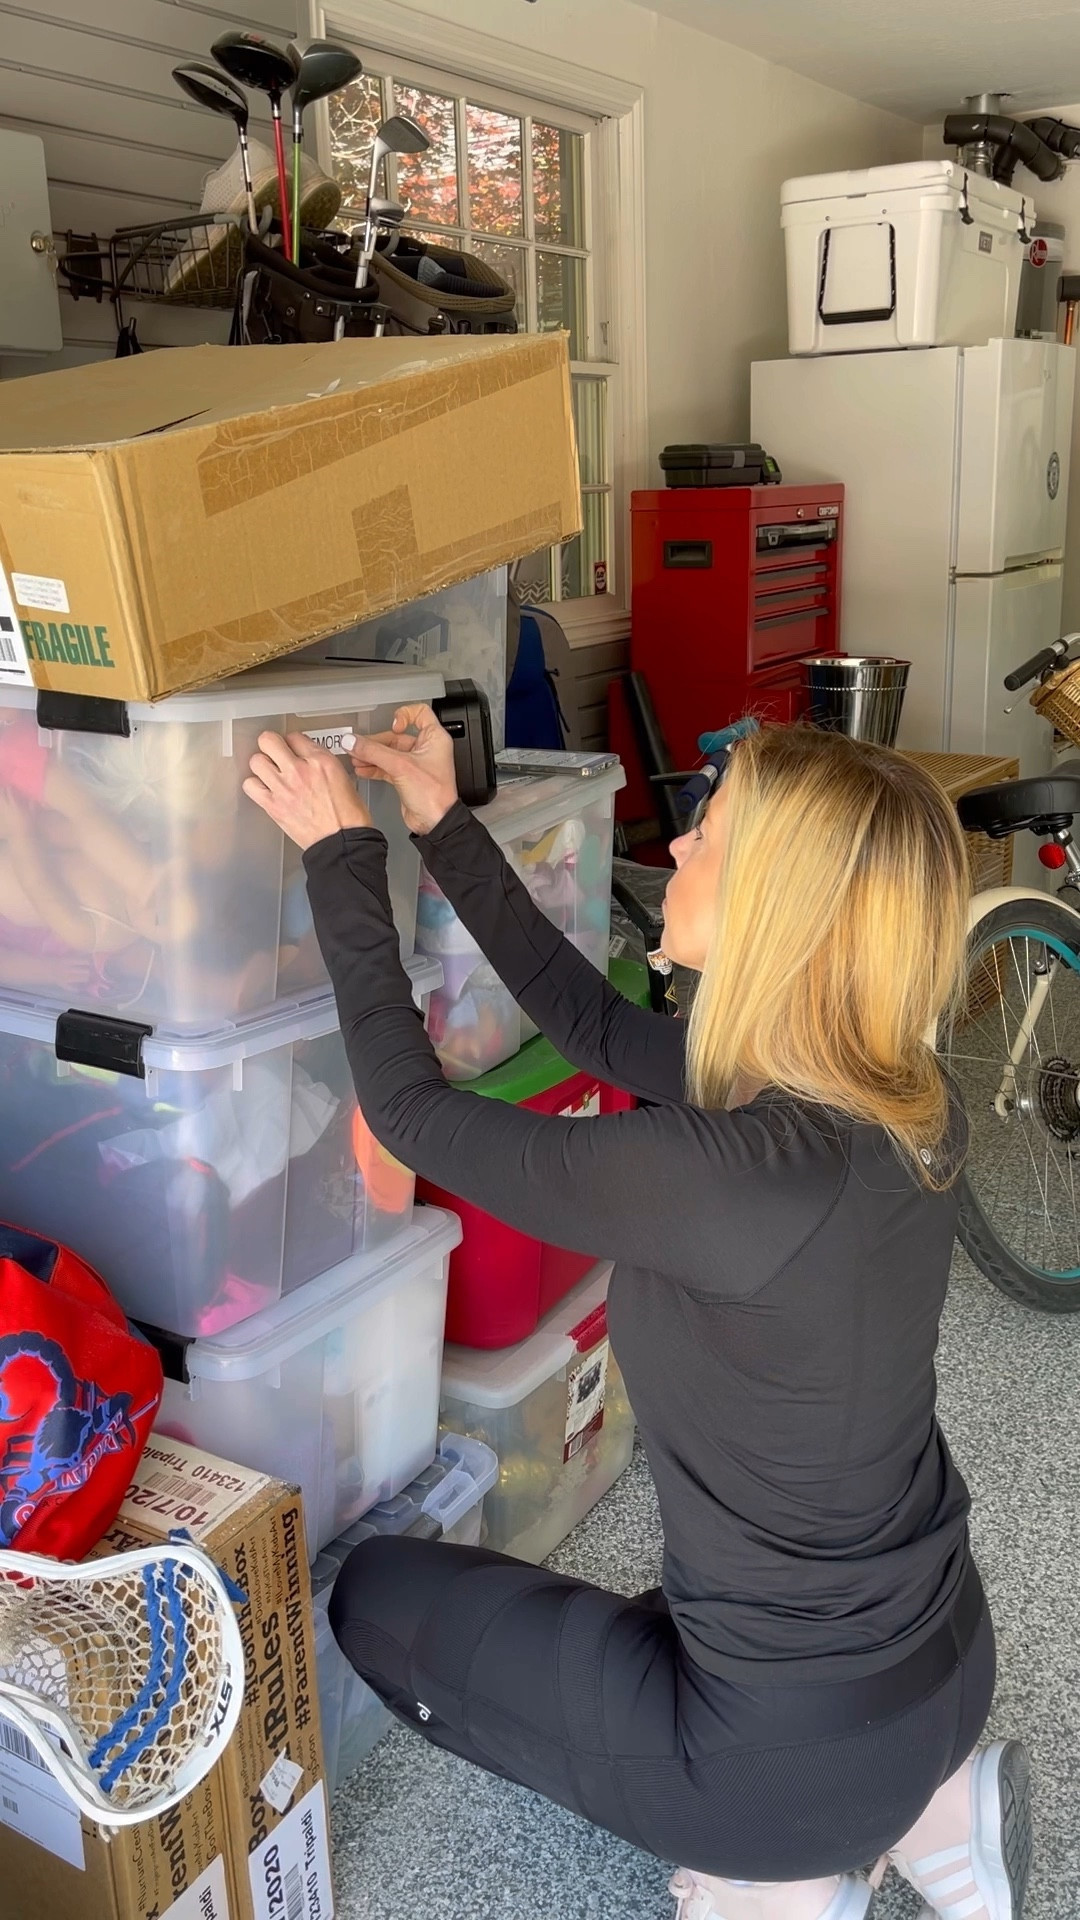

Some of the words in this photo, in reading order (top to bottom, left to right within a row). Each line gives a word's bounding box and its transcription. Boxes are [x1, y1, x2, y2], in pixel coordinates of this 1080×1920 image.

[19, 619, 116, 668] FRAGILE
[311, 734, 344, 750] MOR
[191, 1465, 246, 1494] 123410
[235, 1542, 261, 1707] #IGotThBox
[281, 1507, 311, 1730] #ParentWinning
[210, 1679, 234, 1738] STX
[300, 1808, 318, 1870] Tripaldi
[263, 1844, 286, 1920] /2020
